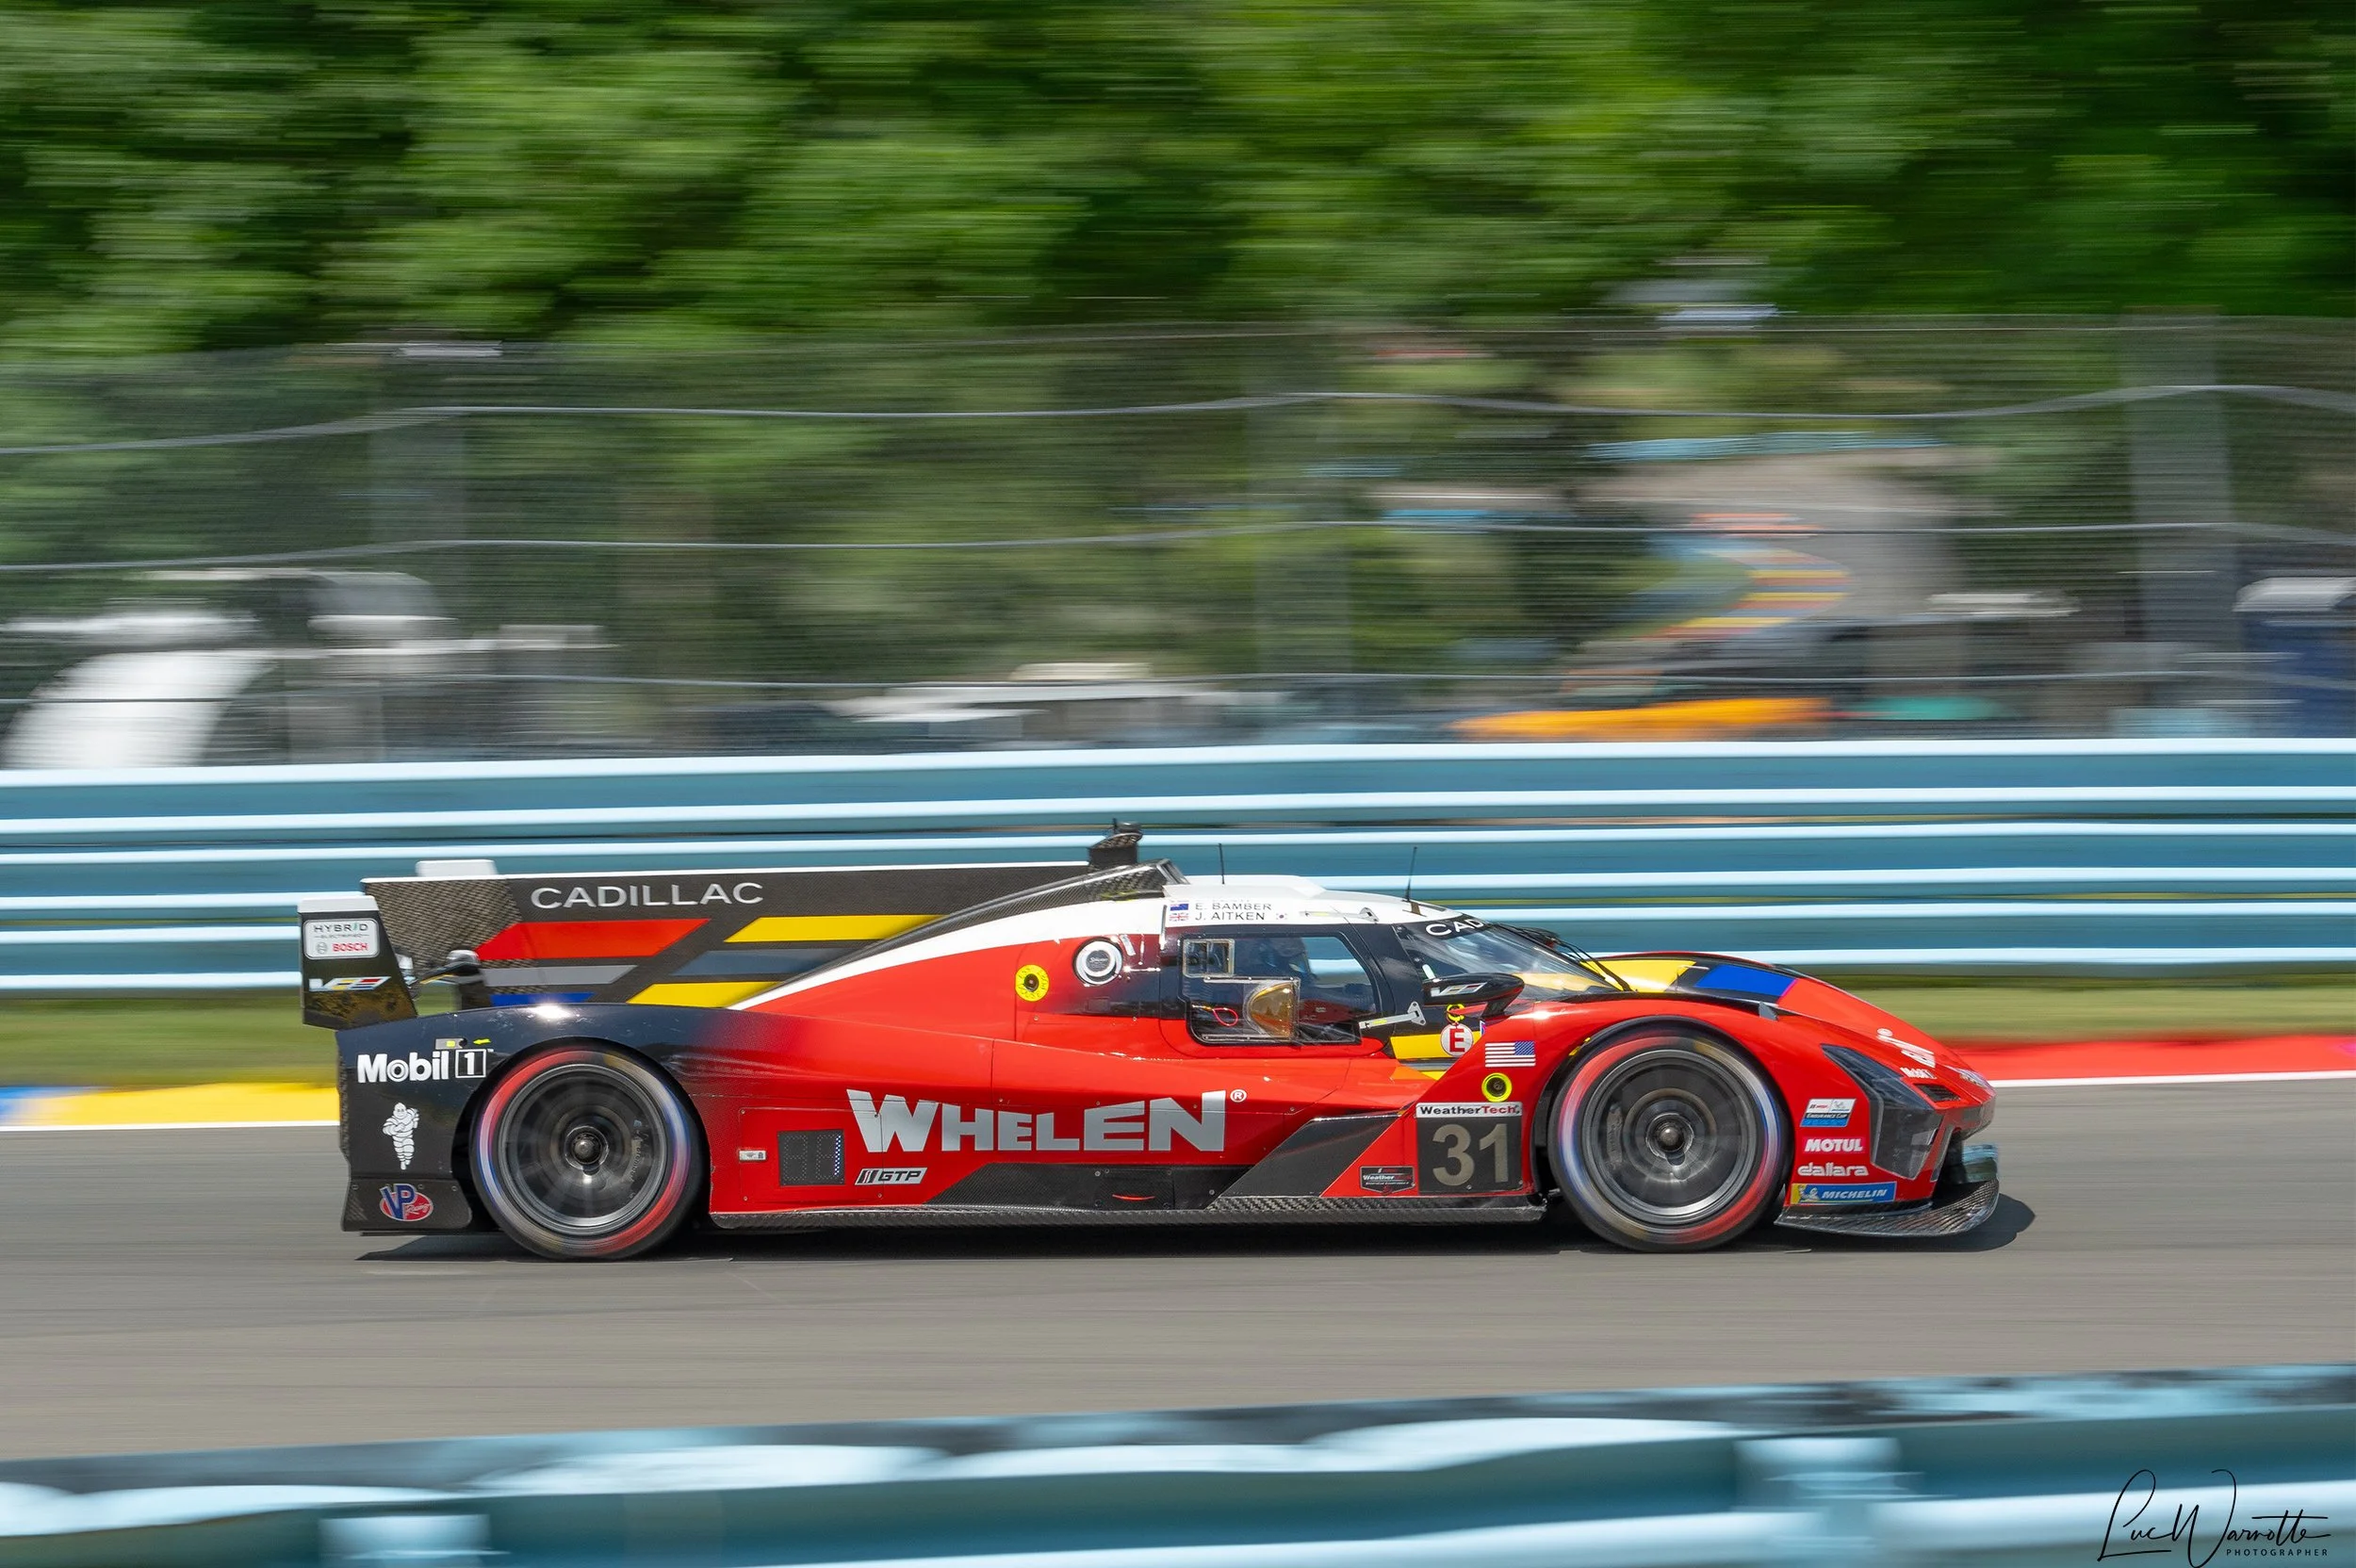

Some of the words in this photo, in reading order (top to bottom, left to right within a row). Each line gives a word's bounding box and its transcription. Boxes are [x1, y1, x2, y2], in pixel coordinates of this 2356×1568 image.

[531, 882, 763, 909] CADILLAC
[1212, 902, 1272, 910] BAMBER
[1195, 911, 1205, 921] J.
[1211, 911, 1266, 921] AITKEN
[313, 923, 368, 933] HYBRID
[332, 942, 368, 952] BOSCH
[1449, 1028, 1465, 1053] E
[357, 1051, 450, 1084] Mobil
[1805, 1138, 1864, 1152] MOTUL
[1432, 1122, 1509, 1186] 31
[877, 1170, 922, 1182] GTP
[1797, 1162, 1870, 1177] dallara
[380, 1184, 416, 1219] VP
[1822, 1189, 1888, 1200] MICHELIN
